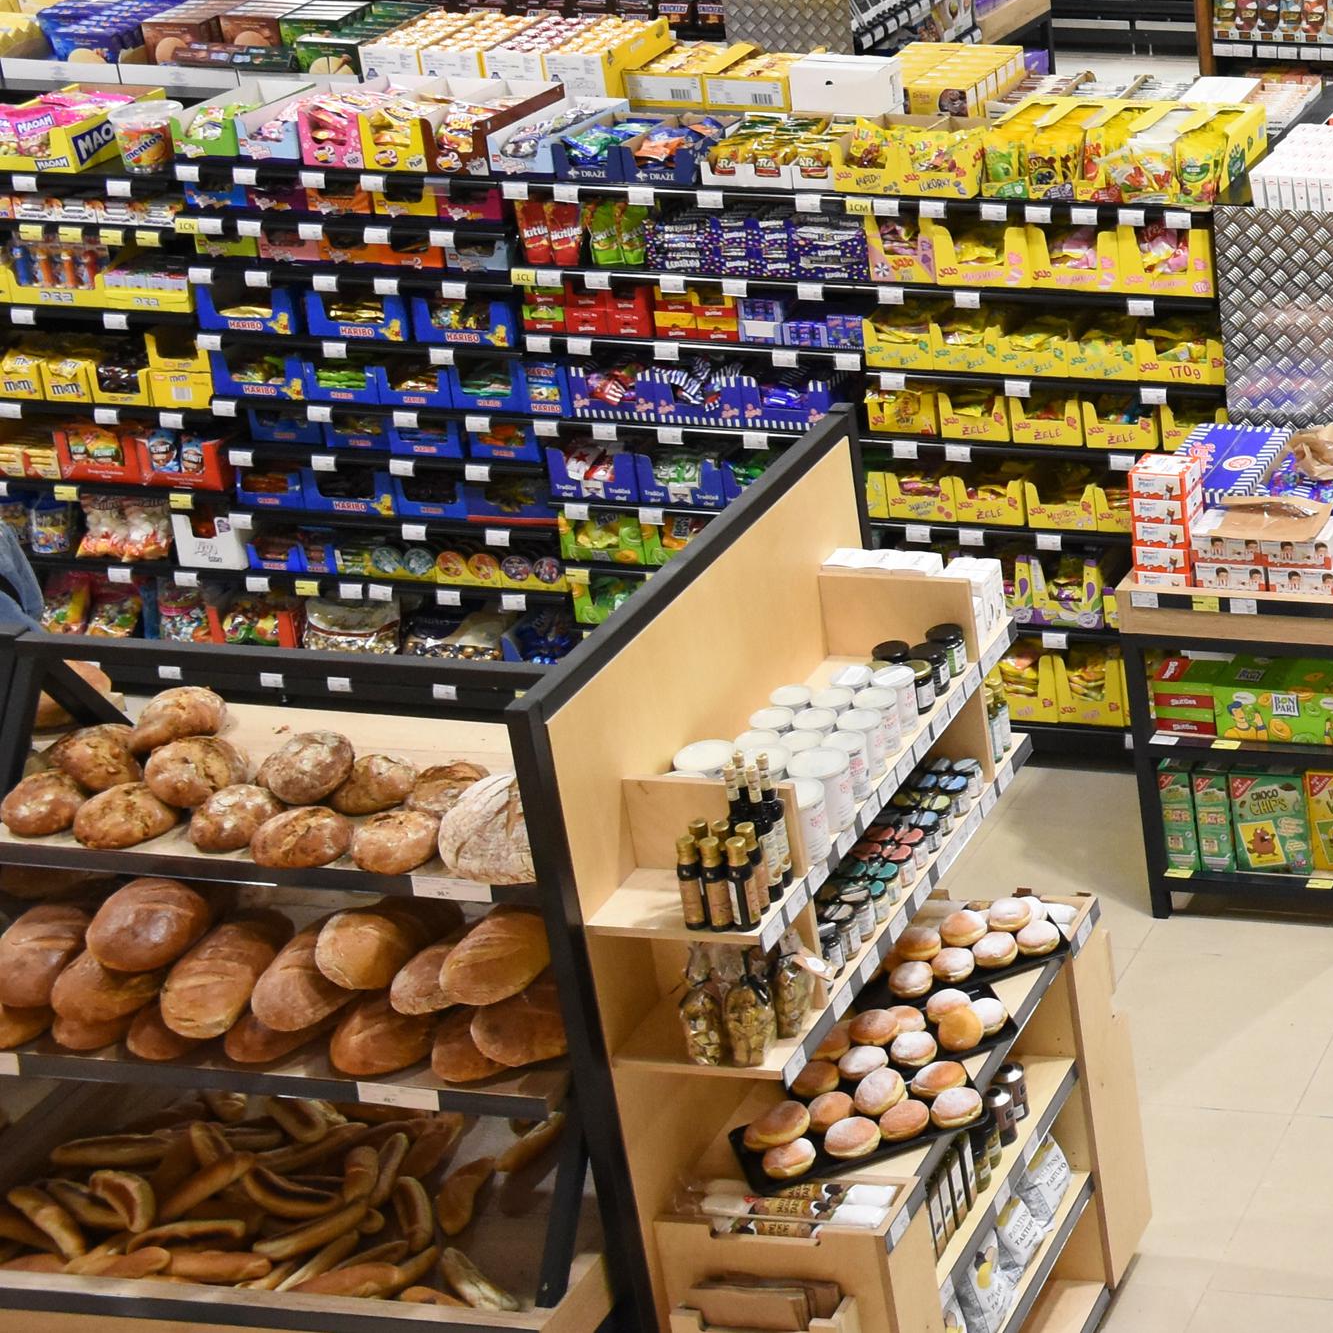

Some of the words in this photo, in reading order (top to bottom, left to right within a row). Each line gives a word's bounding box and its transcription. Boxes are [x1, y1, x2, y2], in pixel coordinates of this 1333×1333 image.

[17, 114, 54, 134] MAOAM
[77, 122, 114, 163] MAO
[125, 133, 164, 162] mentos
[36, 158, 69, 170] MAOAM
[178, 222, 195, 230] 1CN
[516, 272, 531, 282] 1CL
[40, 291, 74, 302] PEZ
[228, 320, 262, 330] HARIBO
[340, 326, 374, 337] HARIBO
[445, 332, 480, 344] HARIBO
[1168, 364, 1202, 380] 170g
[242, 385, 276, 396] HARIBO
[531, 404, 562, 413] HARIBO
[334, 501, 368, 512] HARIBO
[1274, 696, 1295, 705] BON
[1275, 704, 1296, 714] PARI
[1251, 788, 1279, 800] CHOCO
[1250, 798, 1289, 816] CHIPS
